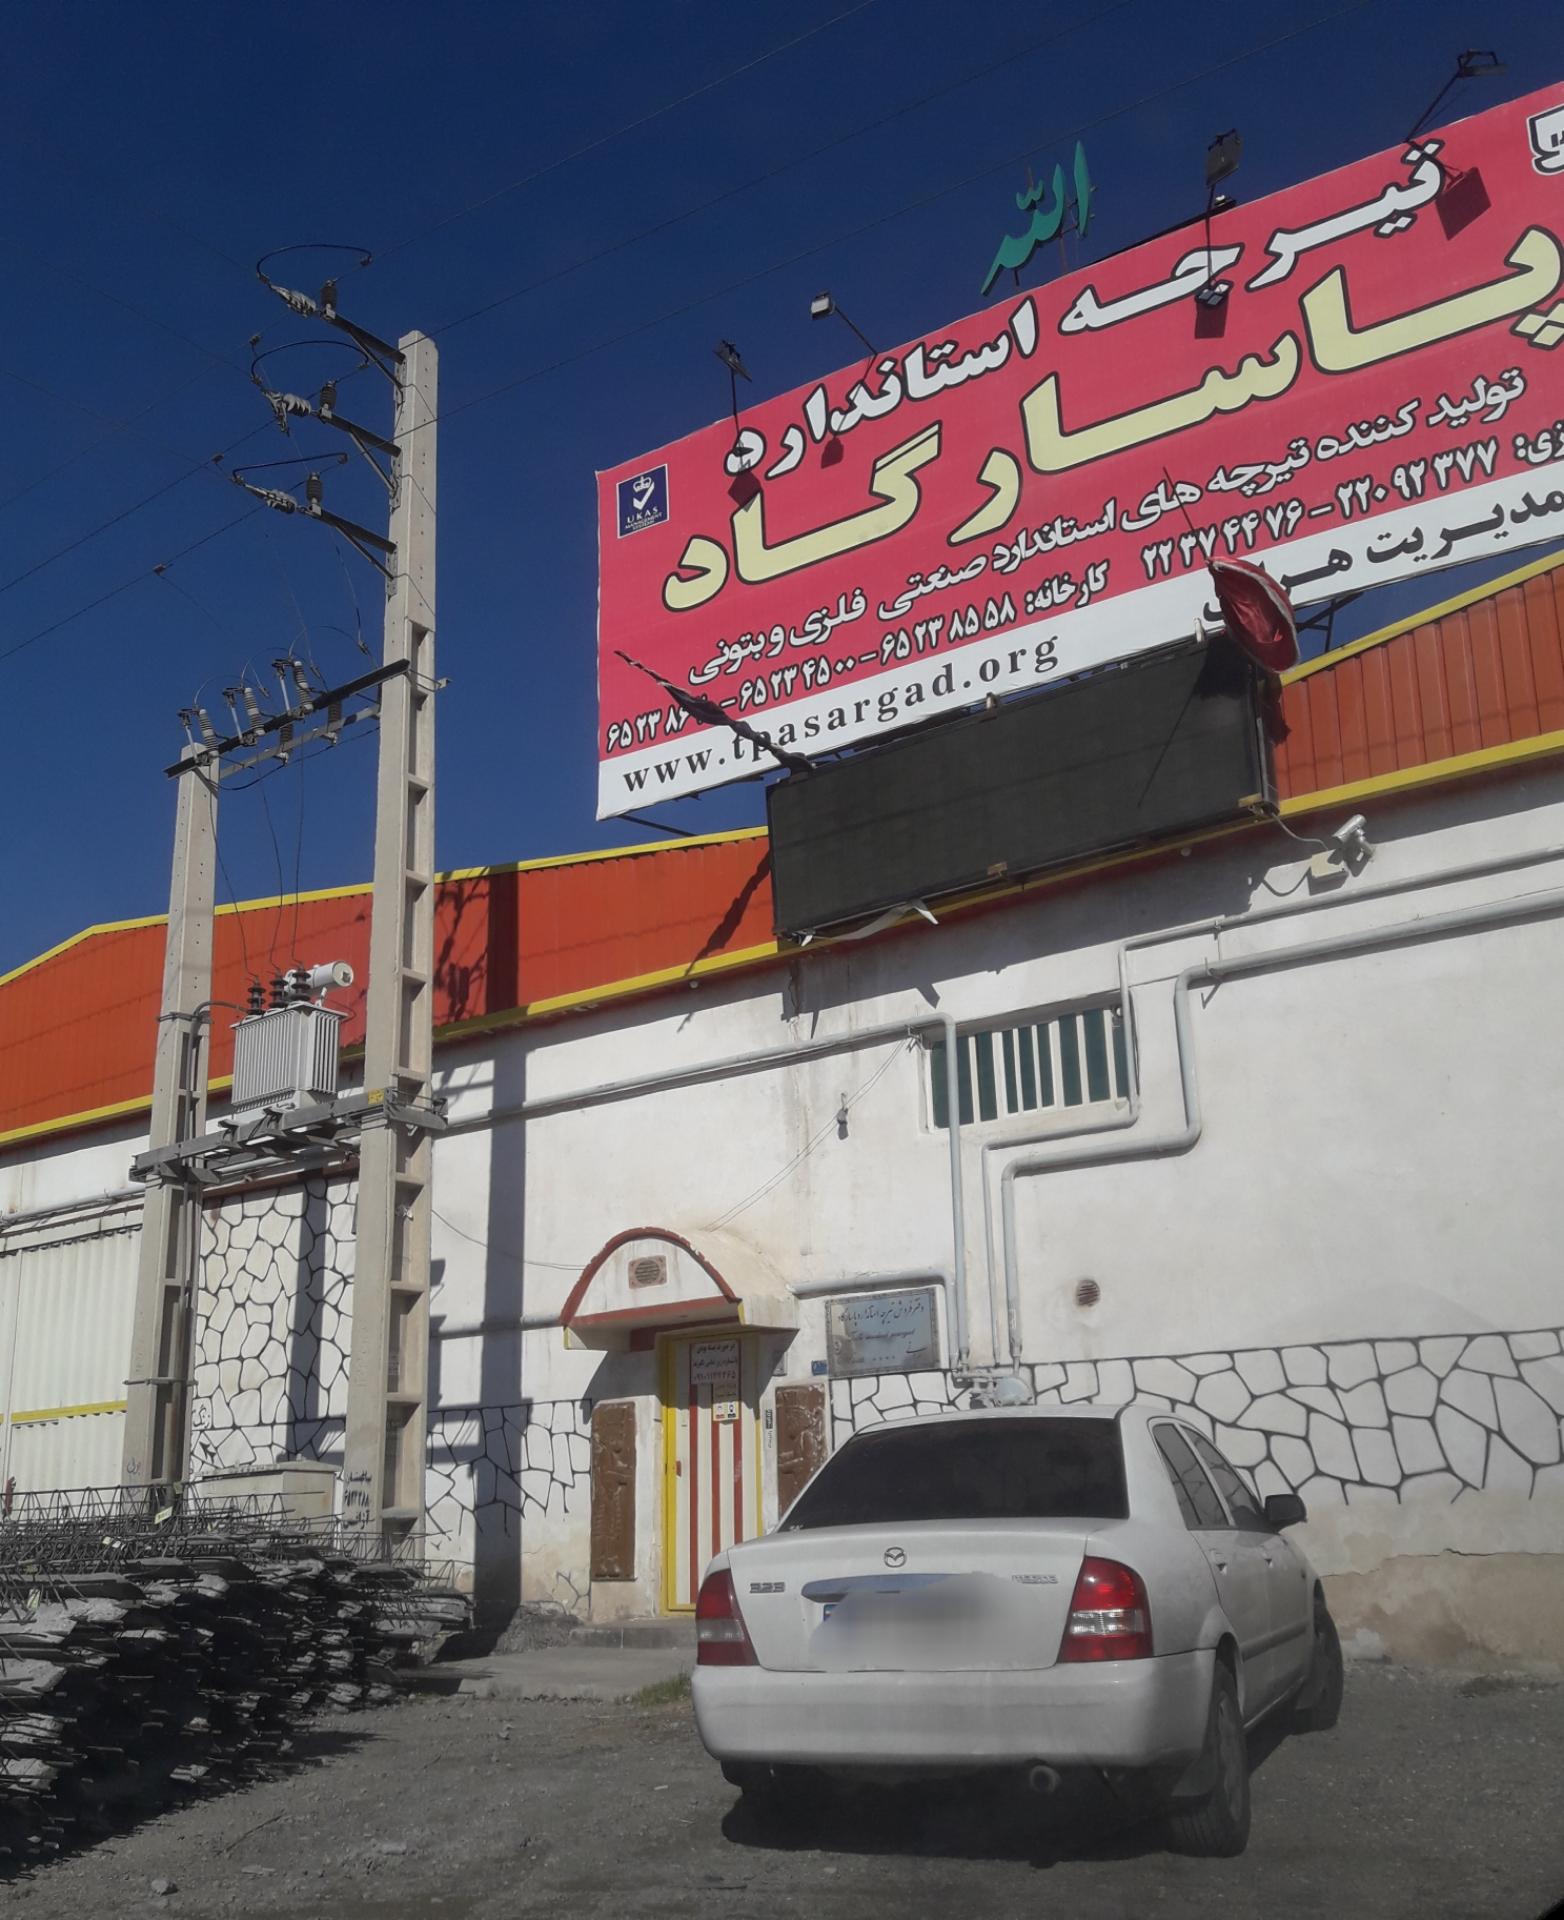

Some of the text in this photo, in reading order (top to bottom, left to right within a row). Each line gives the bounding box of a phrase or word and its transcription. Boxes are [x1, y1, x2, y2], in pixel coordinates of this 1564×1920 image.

[724, 139, 1445, 483] تیرچه استاندارد
[662, 226, 1564, 612] پاسارگاد
[1427, 367, 1527, 427] تولید
[1315, 398, 1421, 461] کننده
[1206, 437, 1311, 496] تیرچه
[627, 506, 659, 524] UKAS
[992, 497, 1117, 575] استاندارد
[1121, 481, 1203, 532] های
[1367, 491, 1564, 564] مدیریت
[789, 587, 867, 647] فلزی
[877, 554, 988, 621] صنعتی
[1025, 560, 1110, 614] کارخانه:
[688, 632, 766, 686] بتونی
[750, 1582, 785, 1594] 323
